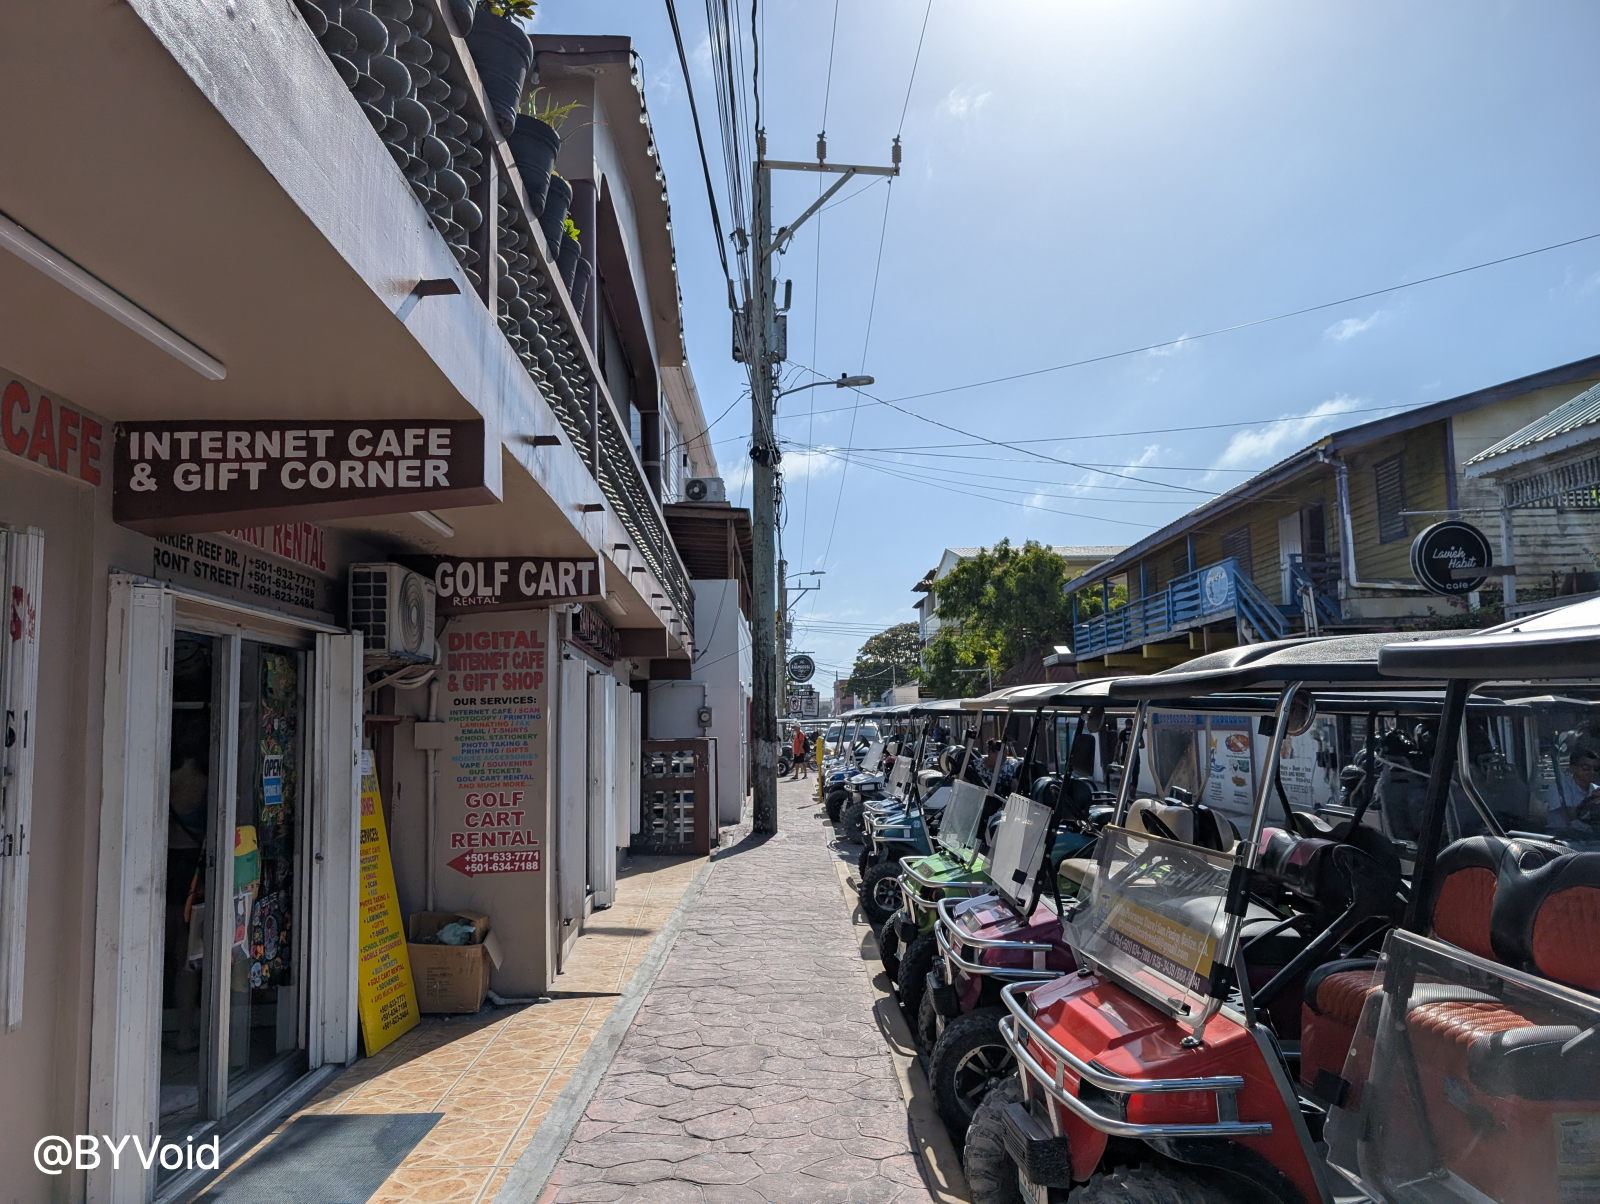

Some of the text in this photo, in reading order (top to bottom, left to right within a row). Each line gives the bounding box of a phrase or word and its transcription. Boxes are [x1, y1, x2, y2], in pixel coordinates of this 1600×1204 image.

[2, 380, 102, 486] CAFE
[130, 428, 451, 460] INTERNET CAFE
[129, 459, 450, 492] & GIFT CORNER
[196, 538, 222, 562] REEF
[225, 547, 240, 568] DR.
[1432, 545, 1466, 559] Lavish
[1448, 556, 1477, 569] Habit
[193, 560, 240, 588] STREET
[249, 558, 316, 588] +501-633-7771
[435, 560, 595, 598] GOLF CART
[248, 571, 316, 600] +501-634-7188
[1446, 582, 1469, 590] cafe
[247, 584, 315, 611] +501-623-2484
[453, 595, 501, 607] RENTAL
[448, 630, 545, 651] DIGITAL
[447, 651, 545, 671] INTERNET CAFE
[447, 671, 544, 692] & GIFT SHOP
[453, 696, 537, 706] OUR SERVICES:
[448, 715, 496, 723] PHOTOCOPY
[450, 709, 489, 717] INTERNET
[493, 726, 528, 734] T-SHIRTS
[264, 758, 285, 777] OPEN
[460, 761, 480, 769] VAPE
[465, 791, 524, 808] GOLF
[465, 810, 525, 829] CART
[451, 829, 539, 849] RENTAL
[464, 851, 540, 863] +501-633-7771
[464, 861, 540, 873] +501-634-7188
[381, 969, 391, 981] CART
